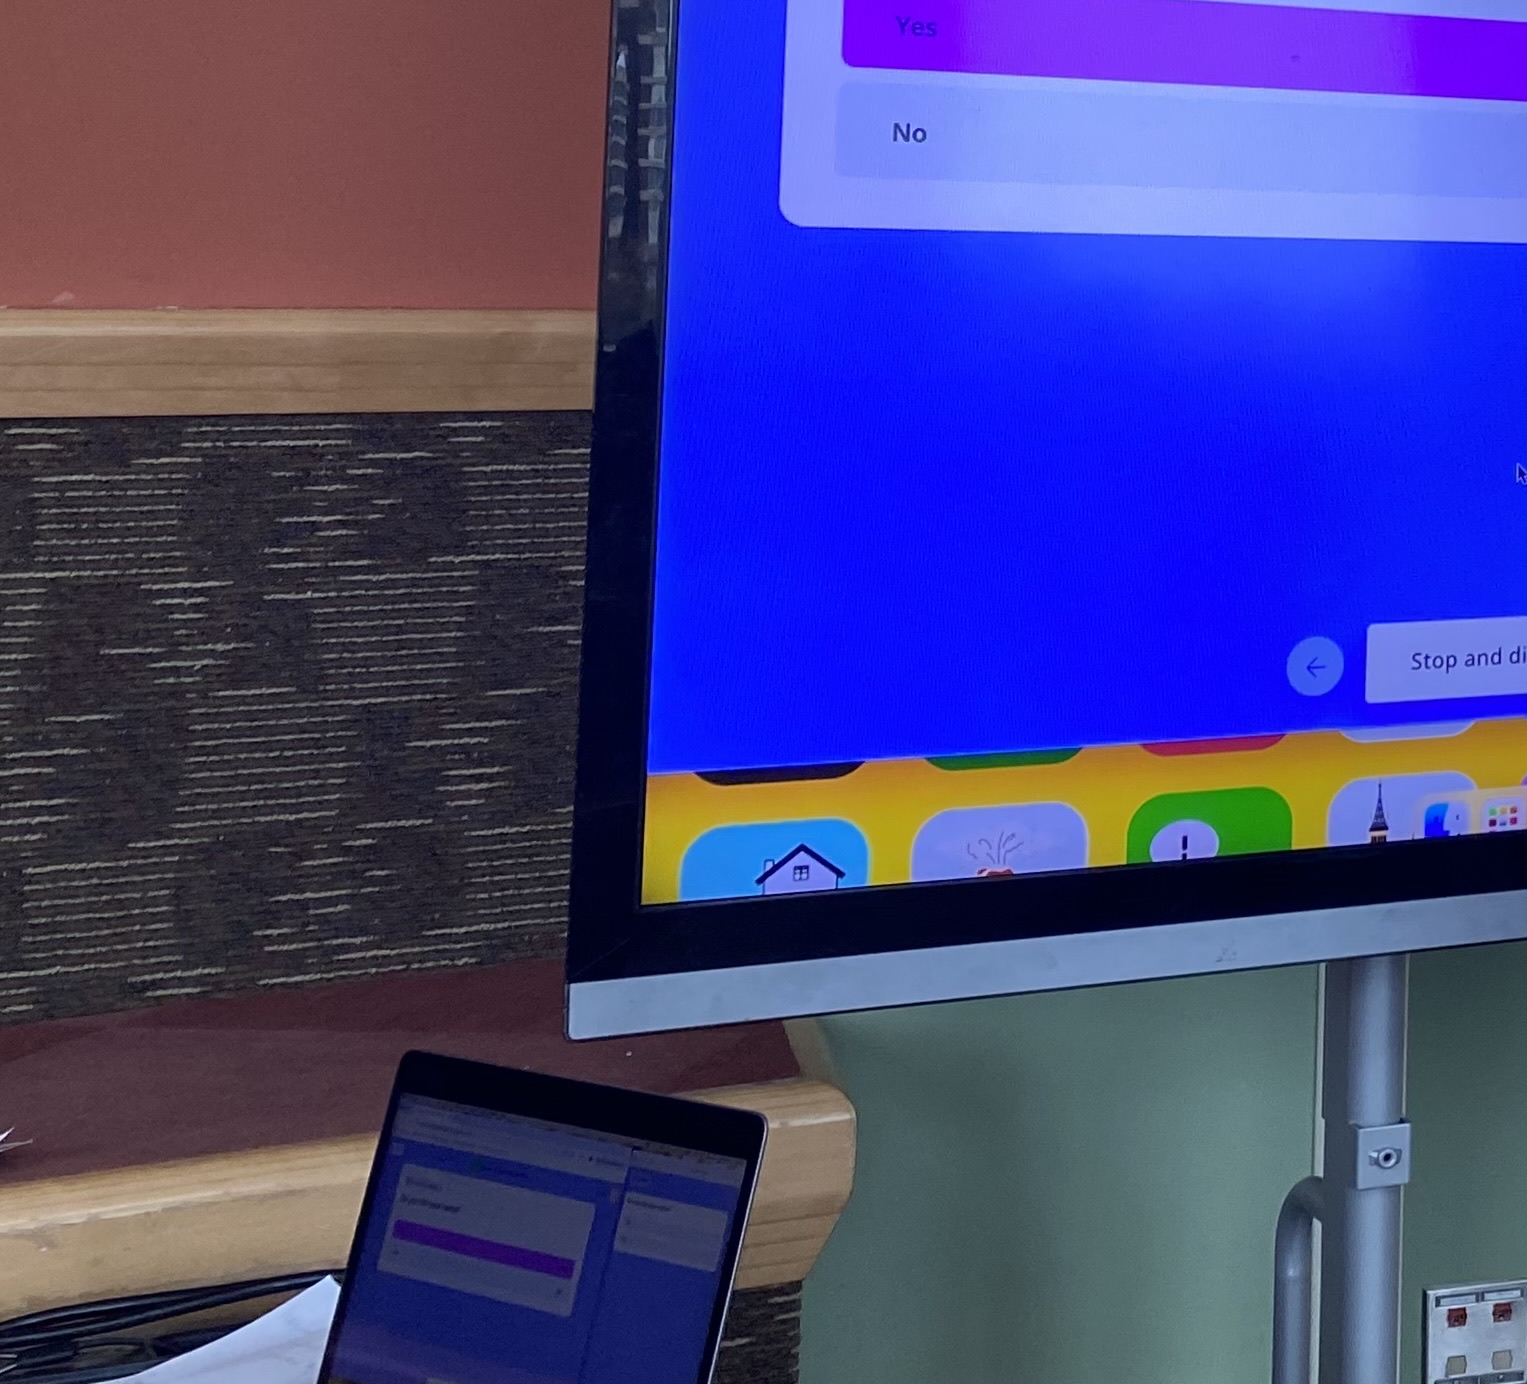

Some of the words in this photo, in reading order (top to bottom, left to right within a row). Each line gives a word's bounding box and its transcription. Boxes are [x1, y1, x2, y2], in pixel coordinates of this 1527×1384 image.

[896, 15, 938, 39] Yes
[891, 121, 928, 144] No
[1410, 651, 1457, 675] Stop
[1464, 645, 1503, 668] and
